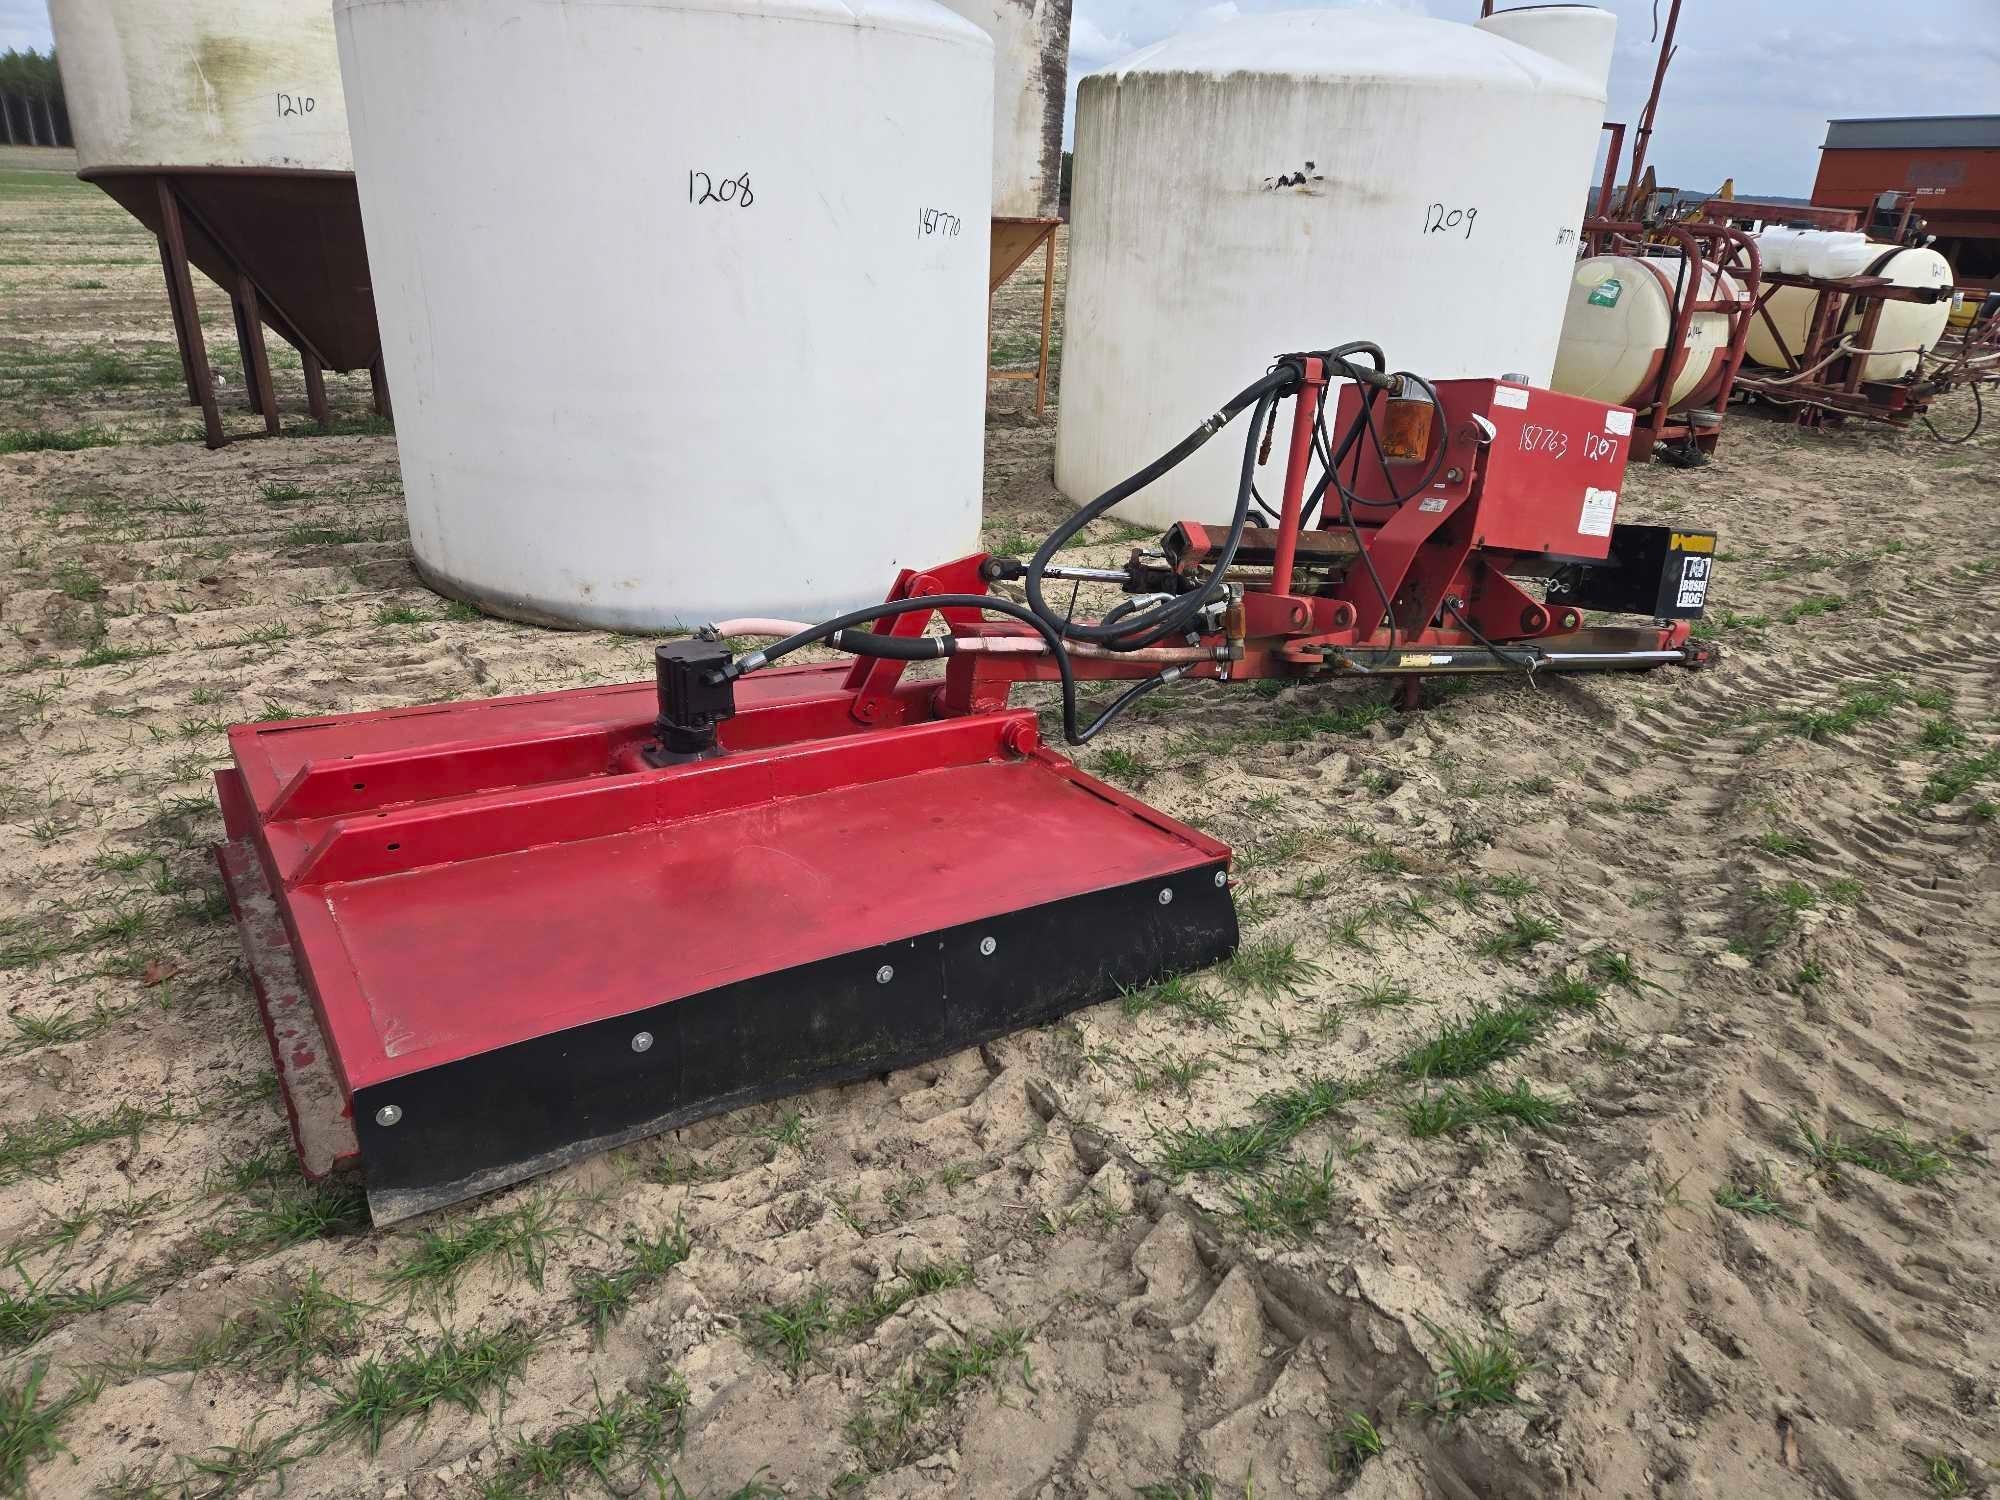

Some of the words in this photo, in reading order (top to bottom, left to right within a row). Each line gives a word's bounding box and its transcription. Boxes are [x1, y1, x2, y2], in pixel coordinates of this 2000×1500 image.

[277, 93, 315, 118] 1210
[689, 169, 754, 207] 1208
[1423, 203, 1478, 239] 1209
[1518, 423, 1568, 460] 187763
[1583, 431, 1618, 464] 1207
[1681, 592, 1702, 604] HOG
[1682, 579, 1706, 592] BUSH
